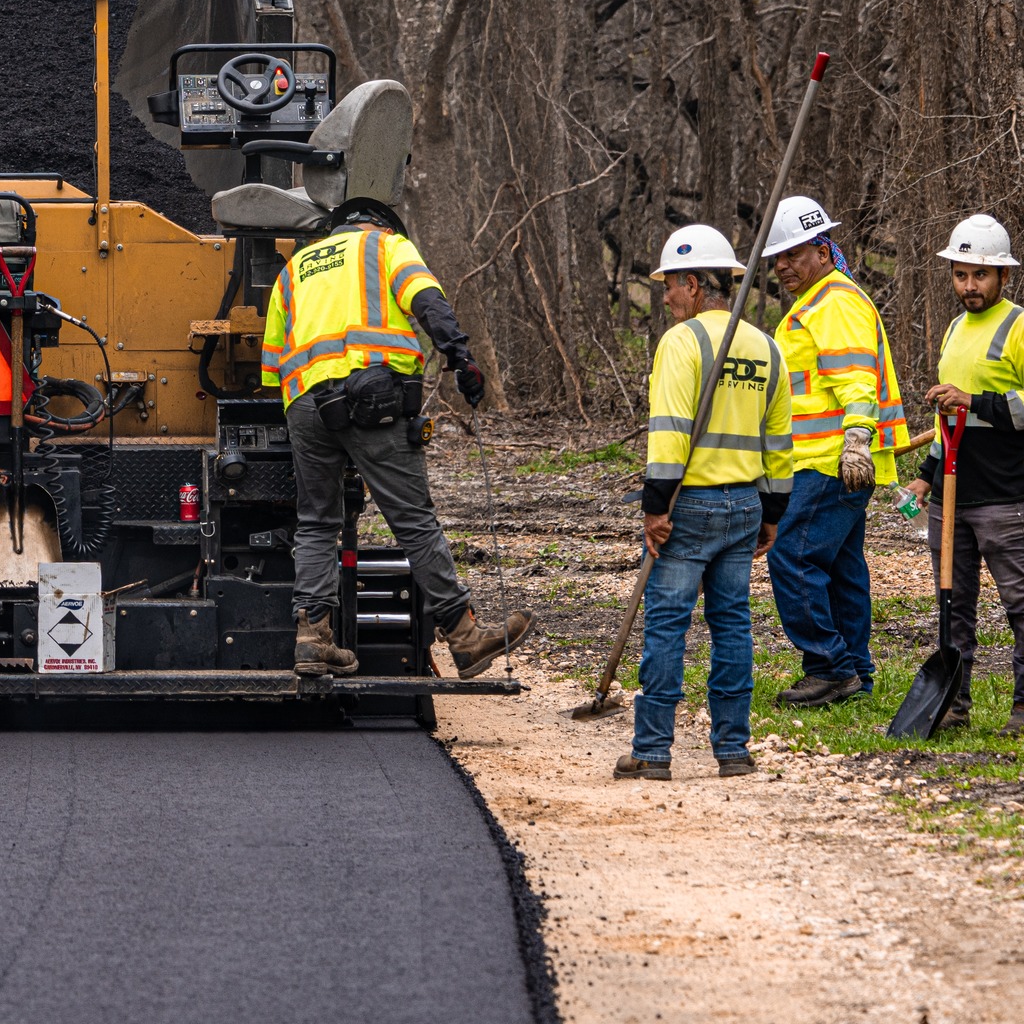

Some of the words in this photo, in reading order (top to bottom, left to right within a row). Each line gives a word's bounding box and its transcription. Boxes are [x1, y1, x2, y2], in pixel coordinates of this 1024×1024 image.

[299, 239, 349, 269] RDC
[720, 357, 768, 383] RDC
[718, 380, 765, 392] PAVING
